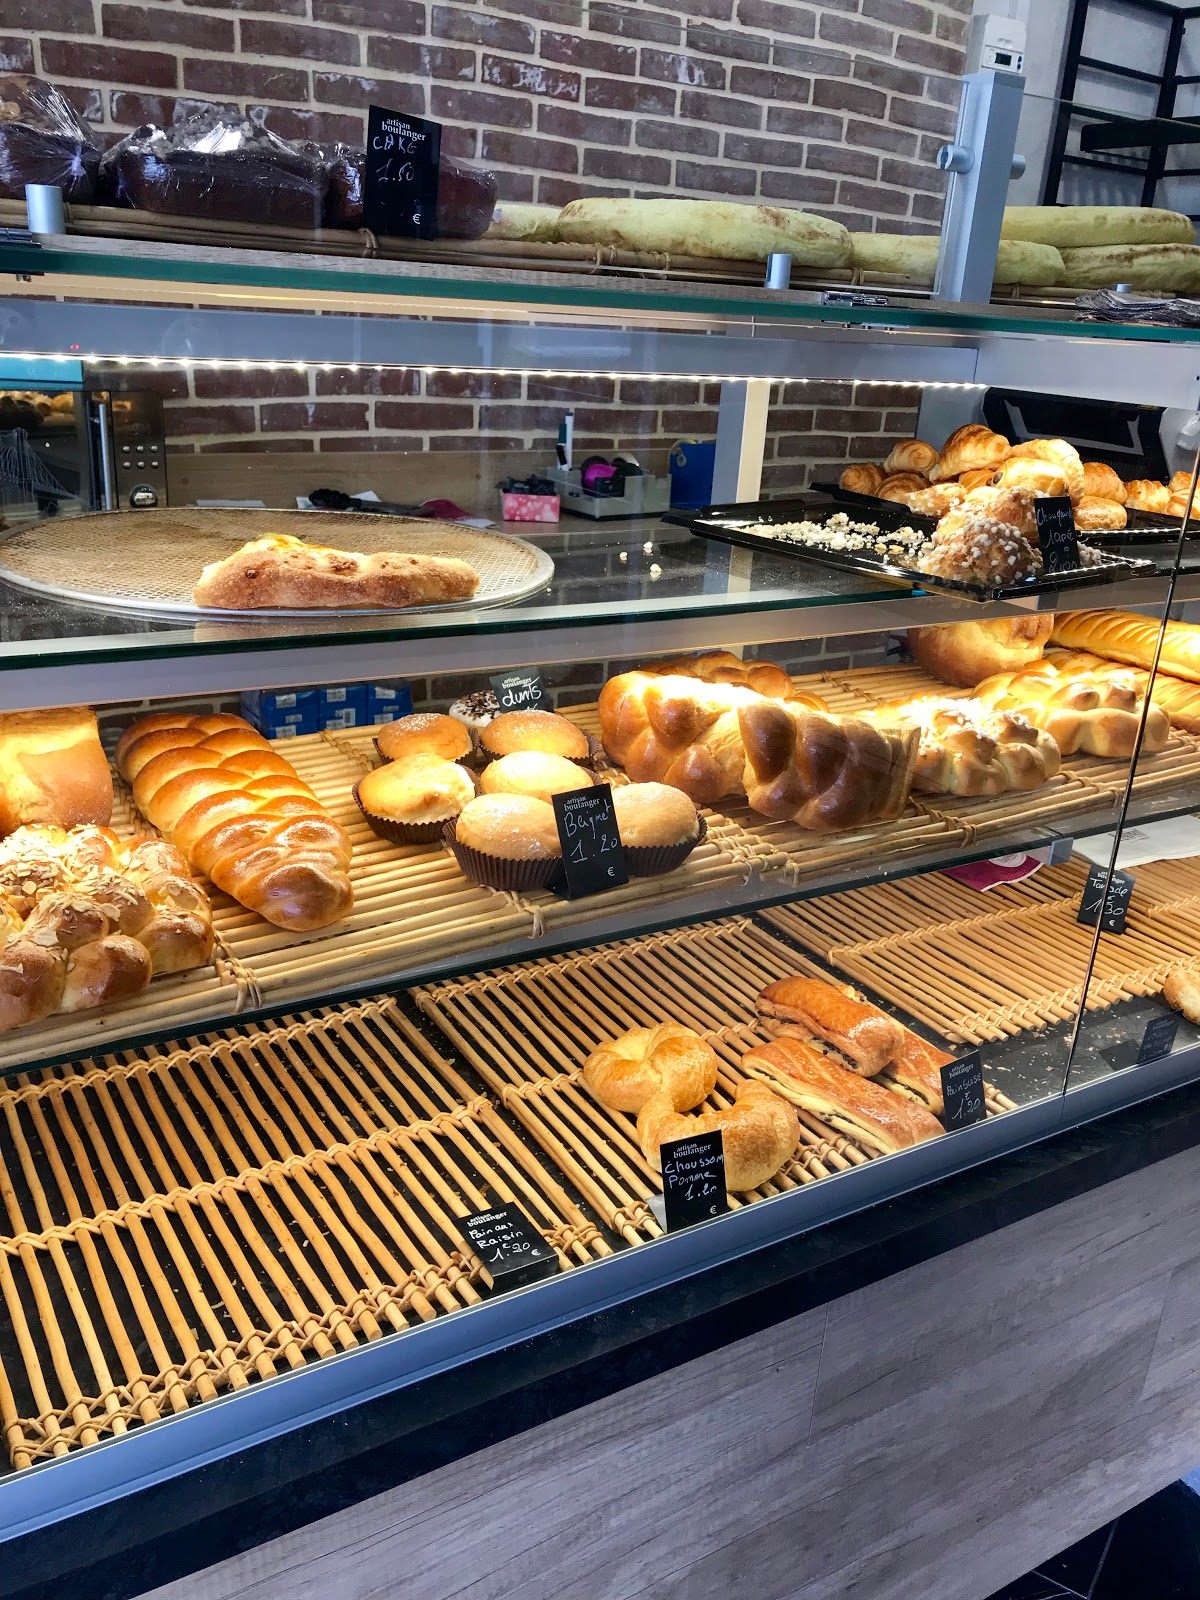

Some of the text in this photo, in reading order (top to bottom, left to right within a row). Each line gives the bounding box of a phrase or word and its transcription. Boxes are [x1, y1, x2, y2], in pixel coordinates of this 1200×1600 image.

[386, 118, 411, 130] artisan
[381, 121, 426, 141] boulanger
[412, 213, 421, 225] €
[563, 798, 600, 812] boulanger
[566, 796, 587, 805] artisan
[570, 833, 618, 863] 1.20
[607, 866, 615, 877] €
[673, 1143, 712, 1159] boulanger
[676, 1142, 698, 1152] artisan
[709, 1204, 717, 1215] €
[467, 1211, 508, 1228] boulanger
[468, 1228, 493, 1240] Pain
[476, 1230, 524, 1250] Raisin
